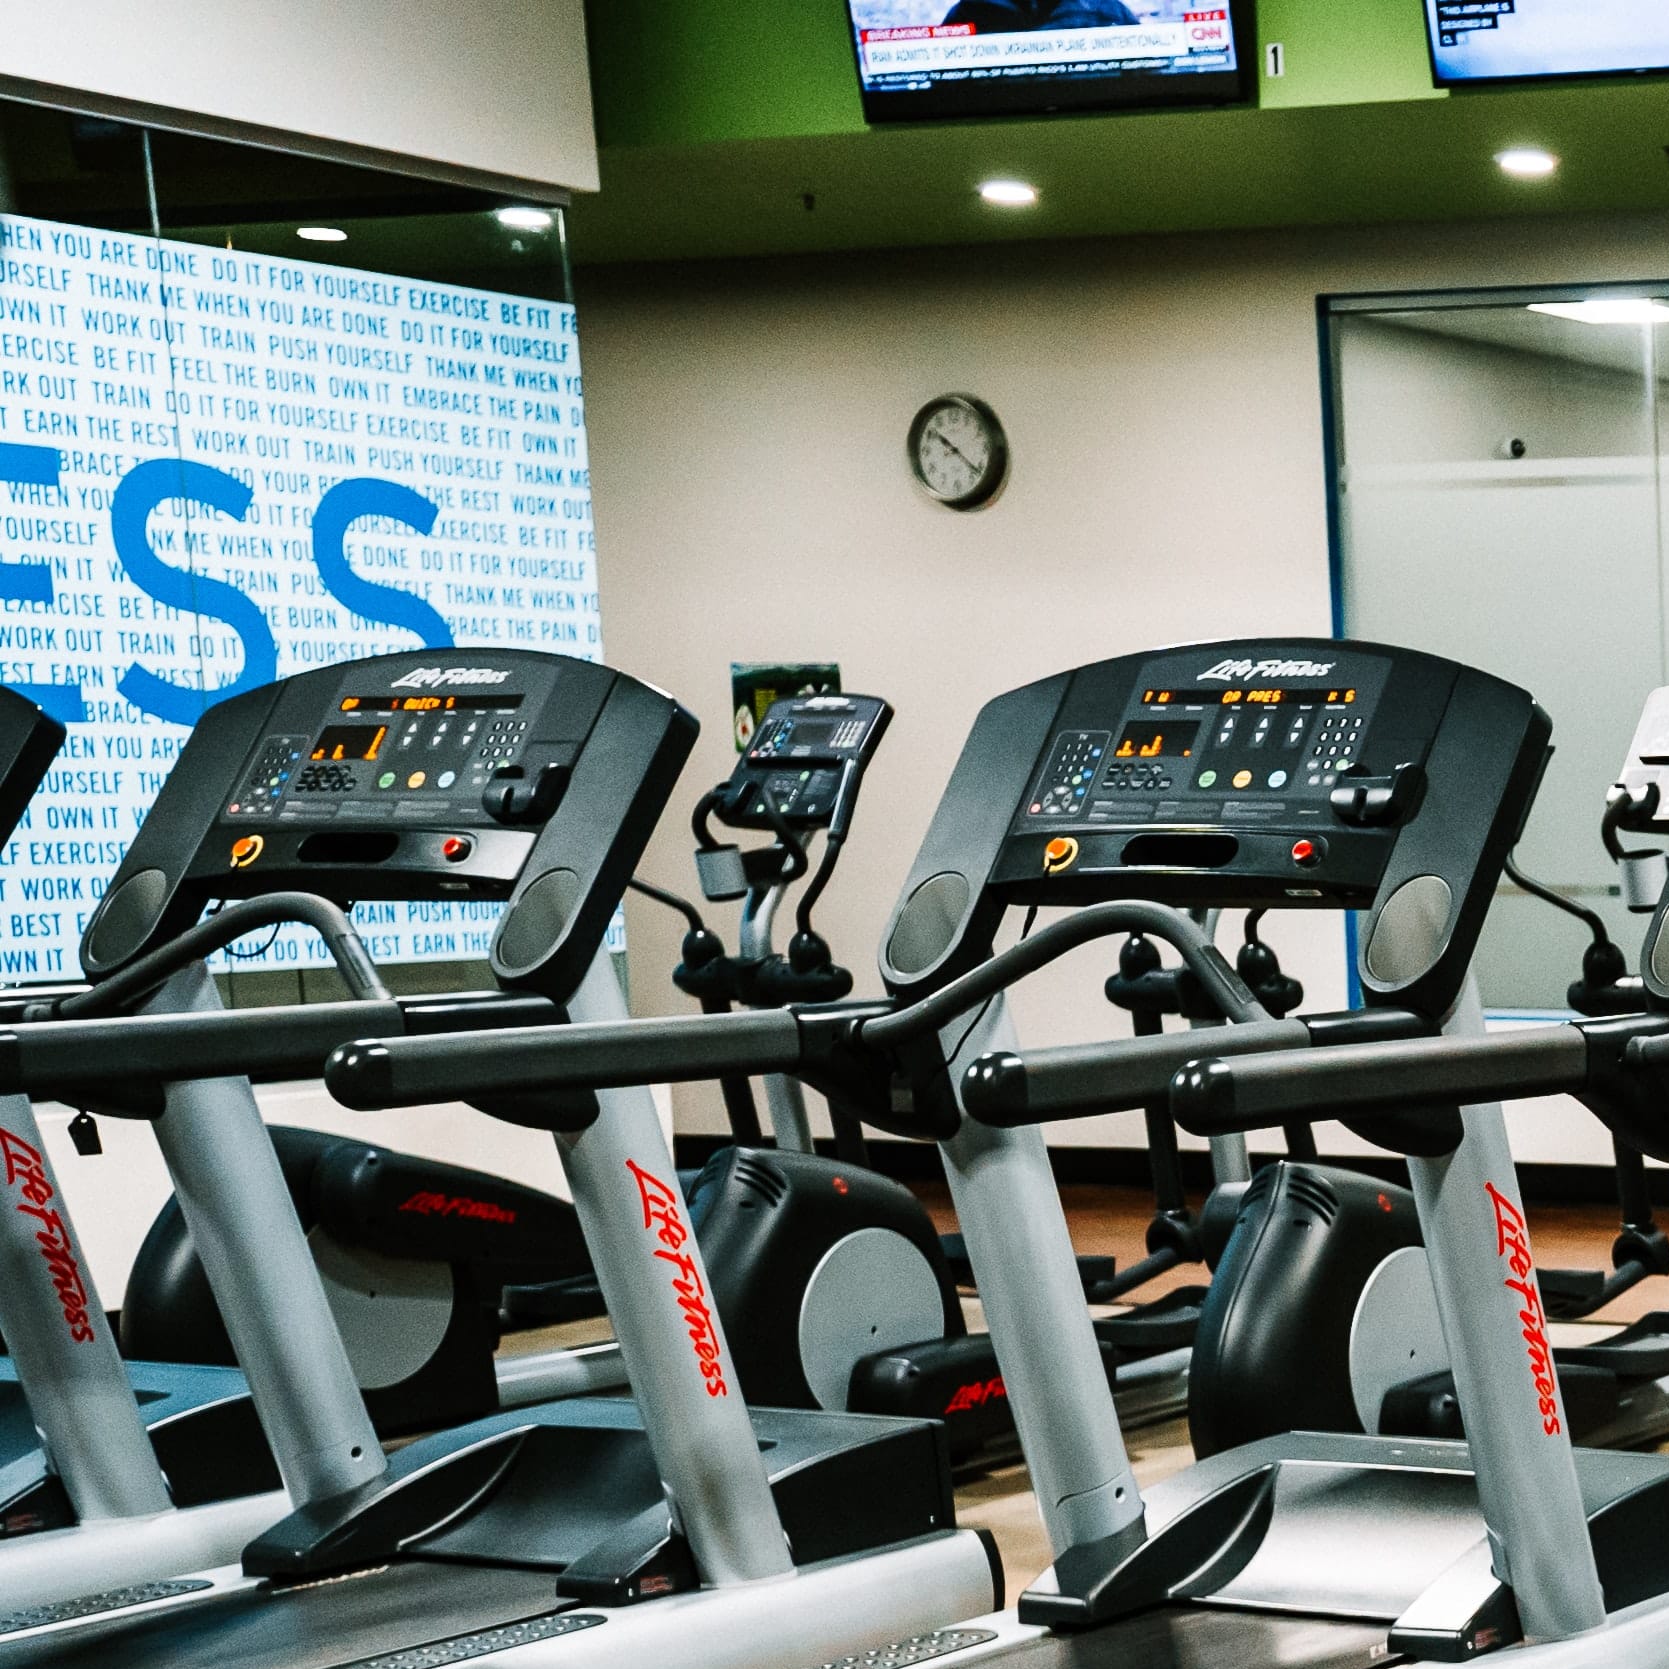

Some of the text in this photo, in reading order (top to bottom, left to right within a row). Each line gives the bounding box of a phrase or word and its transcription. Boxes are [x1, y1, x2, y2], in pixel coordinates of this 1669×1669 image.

[1191, 27, 1222, 41] CNN
[1271, 45, 1278, 75] 1
[0, 223, 551, 330] HEN YOU ARE DONE DO IT FOR YOURSELF EXERCISE BE FIT
[87, 273, 568, 363] THANK ME WHEN YOU ARE DONE DO IT FOR YOURSELF
[49, 304, 559, 395] IT WORK OUT TRAIN PUSH YOURSELF THANK ME WHEN
[94, 346, 120, 370] BE
[127, 350, 156, 375] FIT
[224, 363, 259, 388] THE
[266, 368, 316, 395] BURN
[329, 376, 369, 401] OWN
[376, 382, 390, 404] IT
[403, 386, 482, 416] EMBRACE
[489, 397, 519, 420] THE
[524, 402, 560, 425] PAIN
[39, 375, 576, 459] OUT TRAIN DO IT FOR YOURSELF EXERCISE BE FIT OWN IT
[24, 409, 78, 436] EARN
[87, 416, 123, 441] THE
[132, 421, 179, 447] REST
[192, 428, 249, 455] WORK
[256, 435, 290, 459] OUT
[304, 440, 355, 466] TRAIN
[369, 447, 414, 472] PUSH
[420, 453, 503, 482] YOURSELF
[516, 464, 562, 488] THANK
[59, 450, 123, 477] BRACE
[461, 490, 500, 513] REST
[512, 495, 556, 519] WORK
[0, 517, 98, 547] OURSELF
[217, 534, 273, 560] WHEN
[363, 546, 409, 570] DONE
[420, 550, 443, 573] DO
[450, 553, 463, 574] IT
[470, 554, 500, 577] FOR
[507, 557, 586, 584] YOURSELF
[269, 504, 283, 526] IT
[519, 527, 538, 548] BE
[545, 529, 567, 551] FIT
[77, 558, 92, 581] IT
[446, 583, 496, 605] THANK
[120, 598, 577, 642] BE BURN THE PAIN
[66, 629, 104, 654] OUT
[117, 632, 175, 657] TRAIN
[190, 635, 214, 658] DO
[223, 637, 237, 659] IT
[104, 735, 141, 759] YOU
[47, 807, 117, 829] OWN IT
[22, 878, 84, 901] WORK
[11, 912, 62, 936] BEST
[273, 939, 298, 961] DO
[413, 934, 456, 955] EARN
[47, 949, 64, 971] IT
[17, 1203, 94, 1343] Fitness
[626, 1158, 727, 1397] Life Fitness
[1484, 1182, 1560, 1435] Life Fitness
